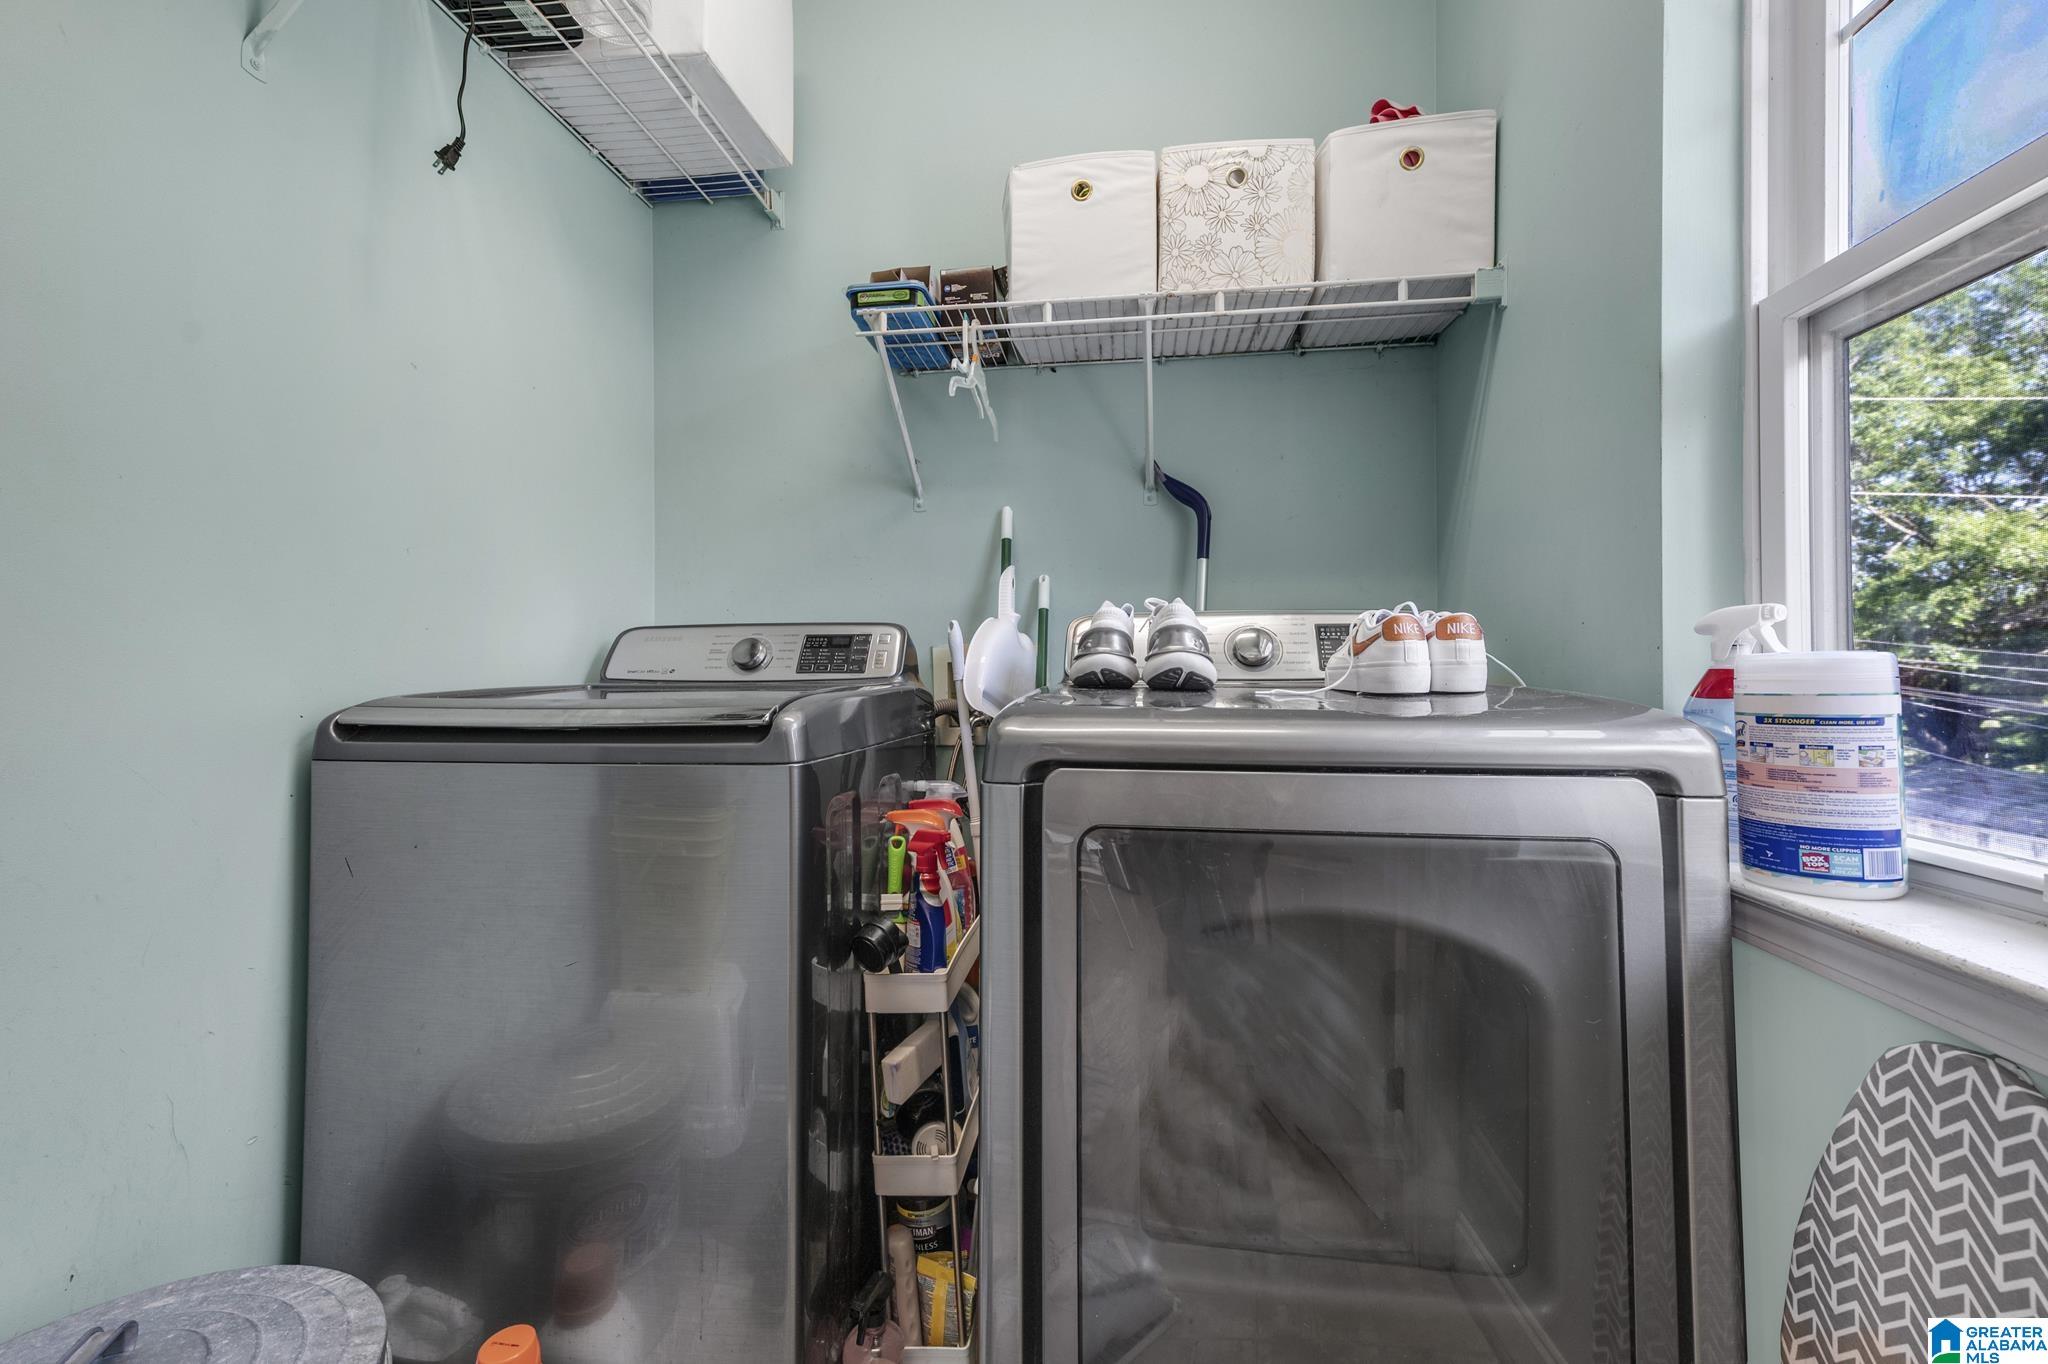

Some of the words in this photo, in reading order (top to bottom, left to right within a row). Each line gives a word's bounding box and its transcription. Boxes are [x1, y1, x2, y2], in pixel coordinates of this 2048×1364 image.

[1393, 622, 1420, 635] NIKE
[1446, 622, 1475, 635] NIKE
[1775, 718, 1816, 726] STRONGER
[1801, 855, 1825, 863] BOX
[912, 1226, 934, 1237] IMAN
[915, 1241, 938, 1251] NLESS
